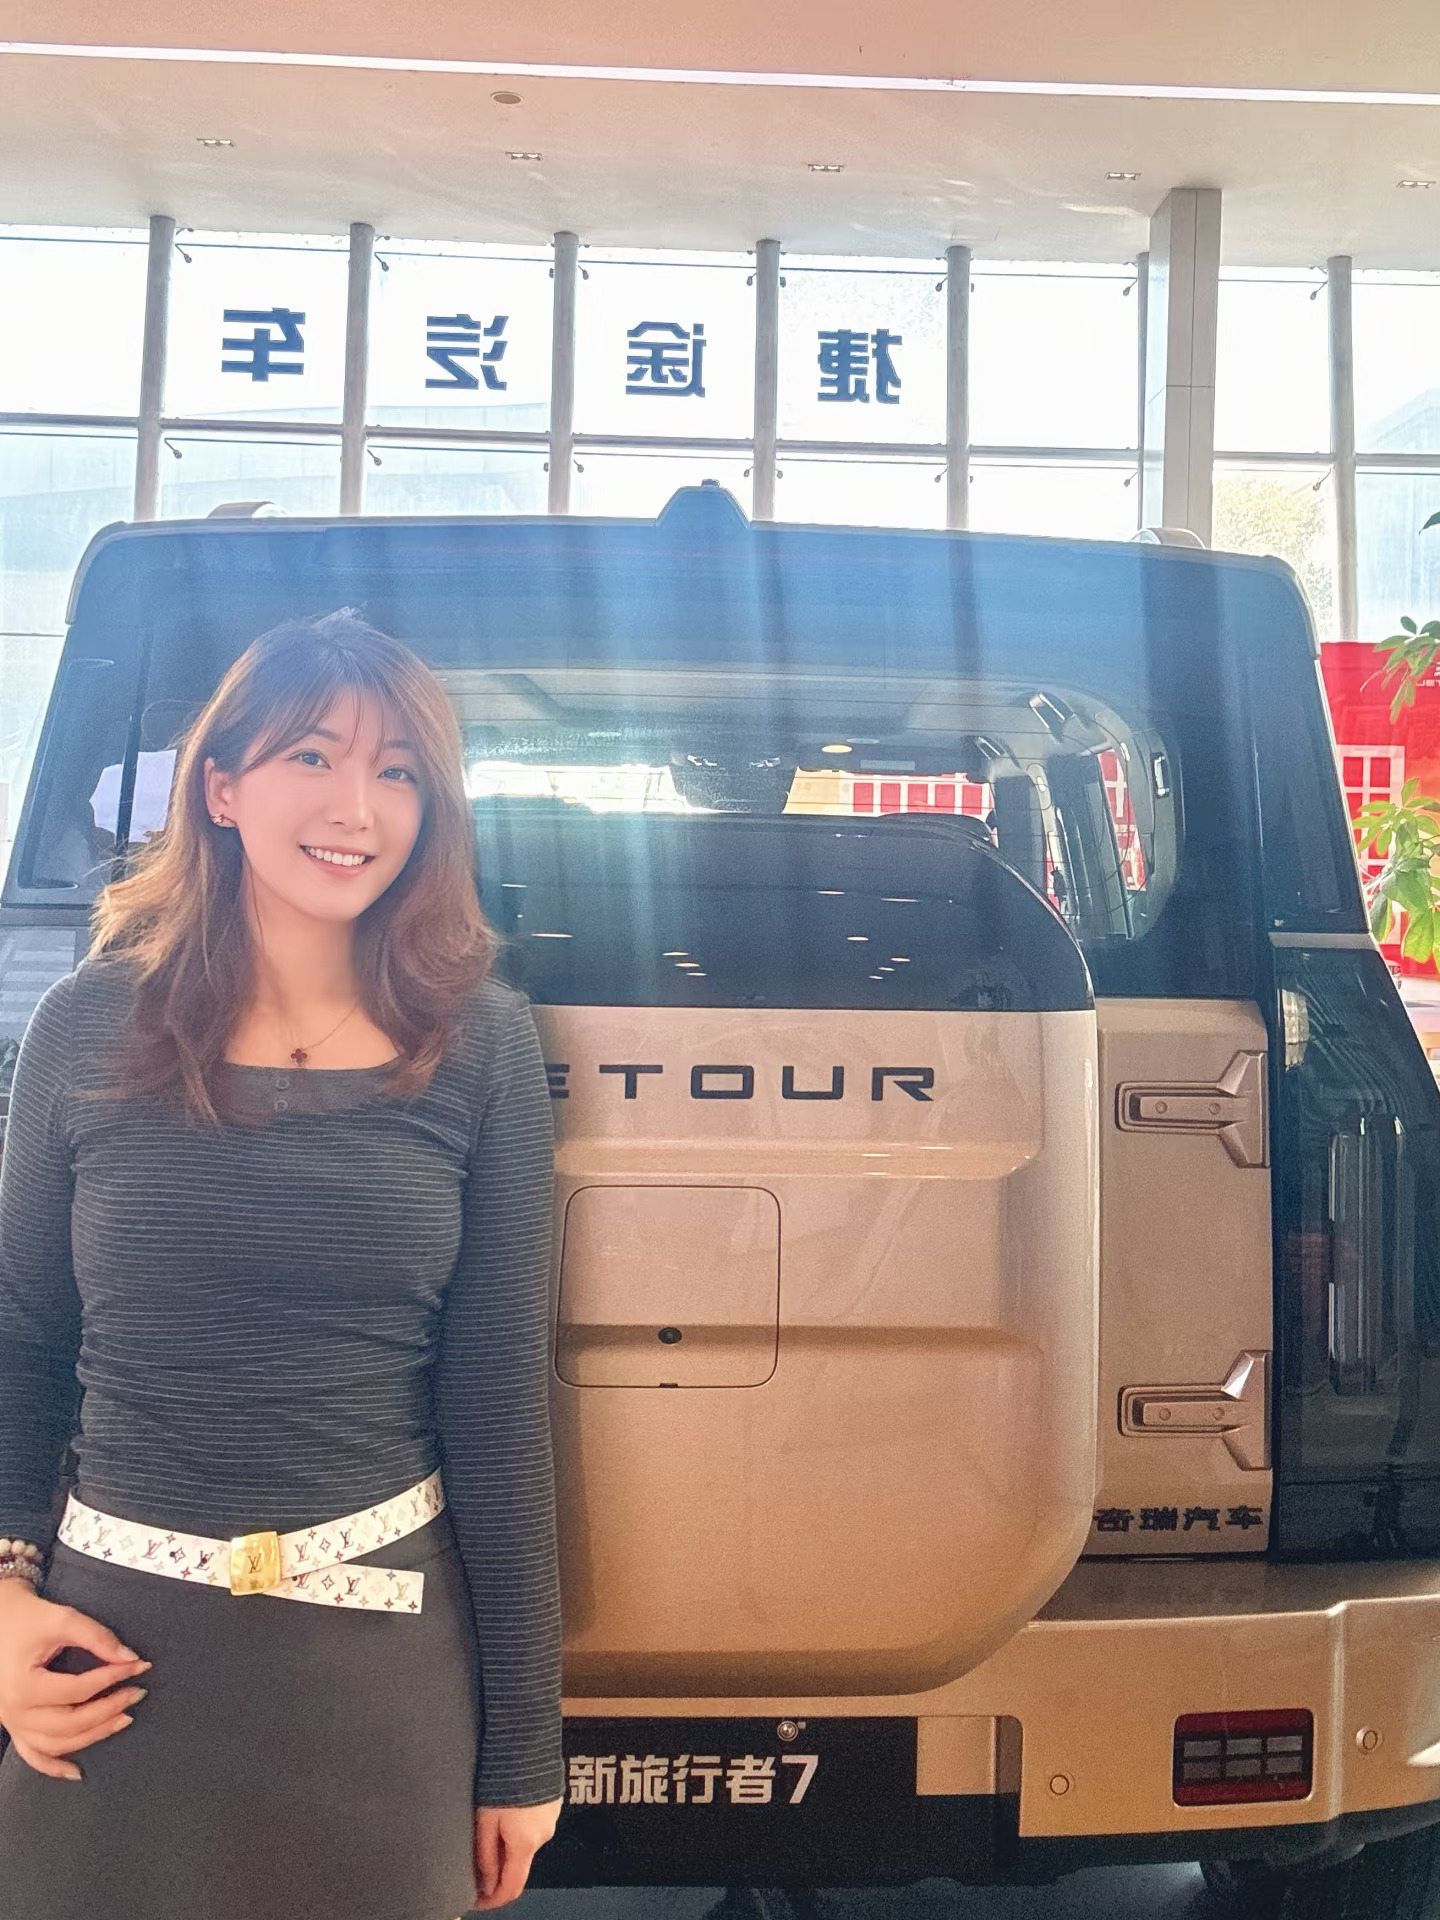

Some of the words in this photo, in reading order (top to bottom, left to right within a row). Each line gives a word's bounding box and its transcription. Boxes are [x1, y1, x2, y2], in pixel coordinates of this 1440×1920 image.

[1093, 1505, 1264, 1532] 奇瑞汽车
[568, 1754, 819, 1805] 新旅行者7
